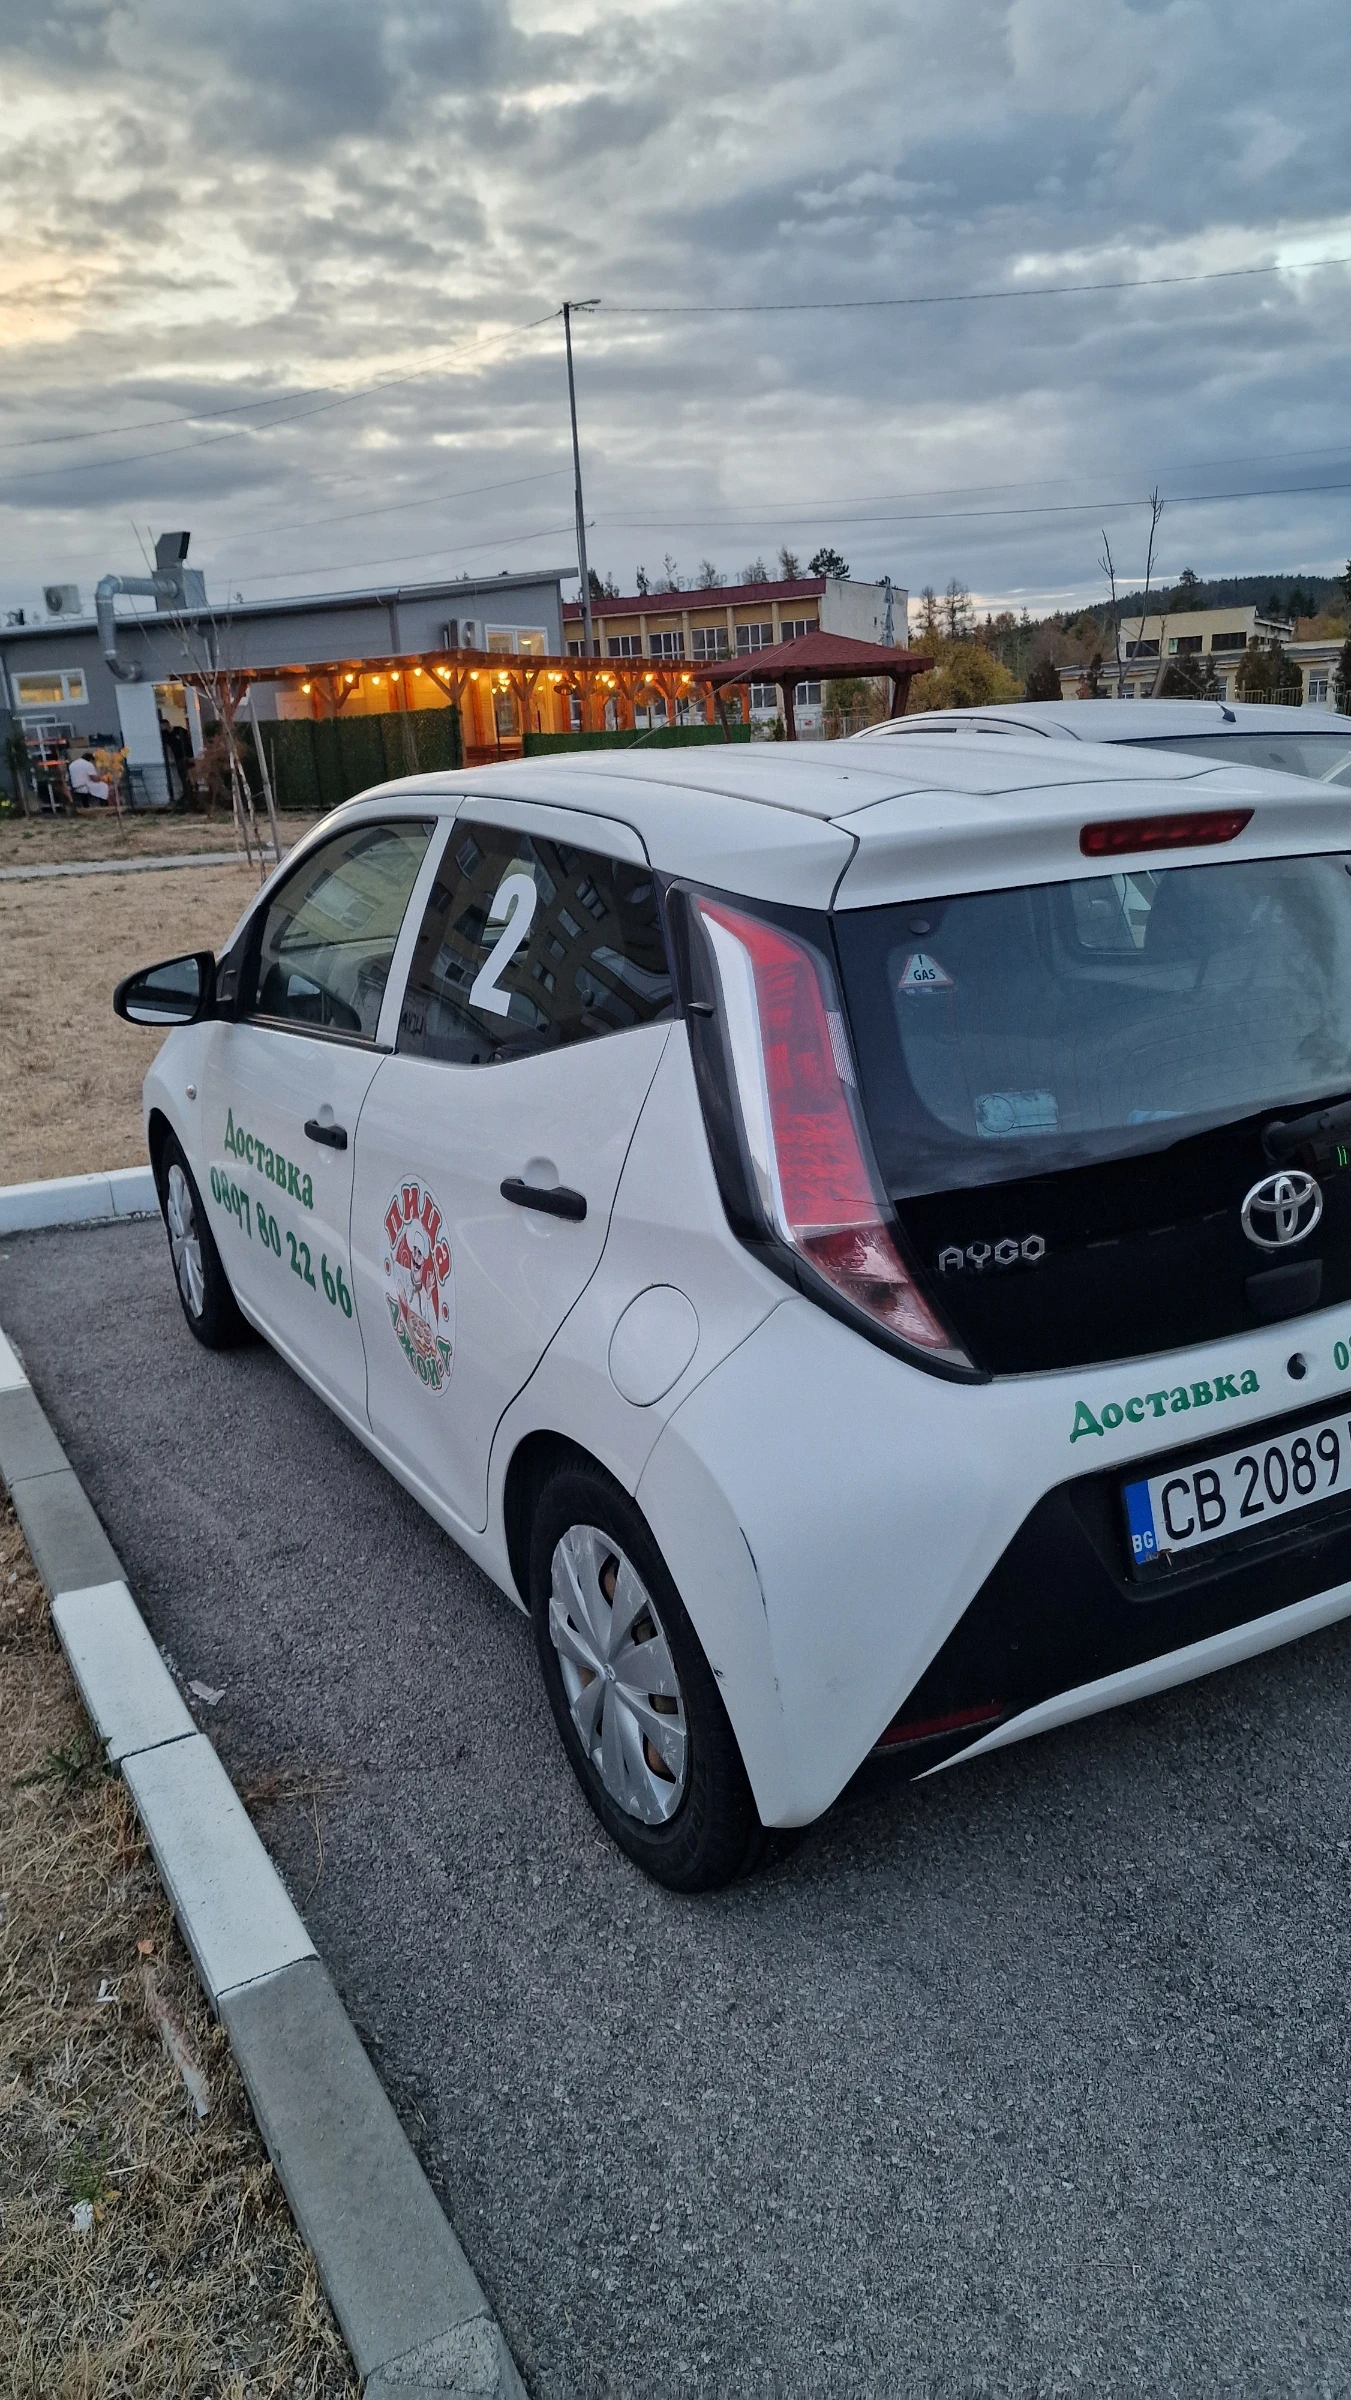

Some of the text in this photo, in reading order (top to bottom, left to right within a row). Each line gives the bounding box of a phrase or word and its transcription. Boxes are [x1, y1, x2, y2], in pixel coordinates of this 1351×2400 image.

[468, 873, 538, 1018] 2
[913, 968, 936, 981] GAS
[223, 1106, 314, 1211] Доставка
[209, 1165, 353, 1319] 0897 80 22 66
[938, 1234, 1046, 1272] AYGO
[1069, 1368, 1261, 1443] Доставка
[1161, 1428, 1341, 1540] CB 2089
[1131, 1530, 1155, 1554] BG
